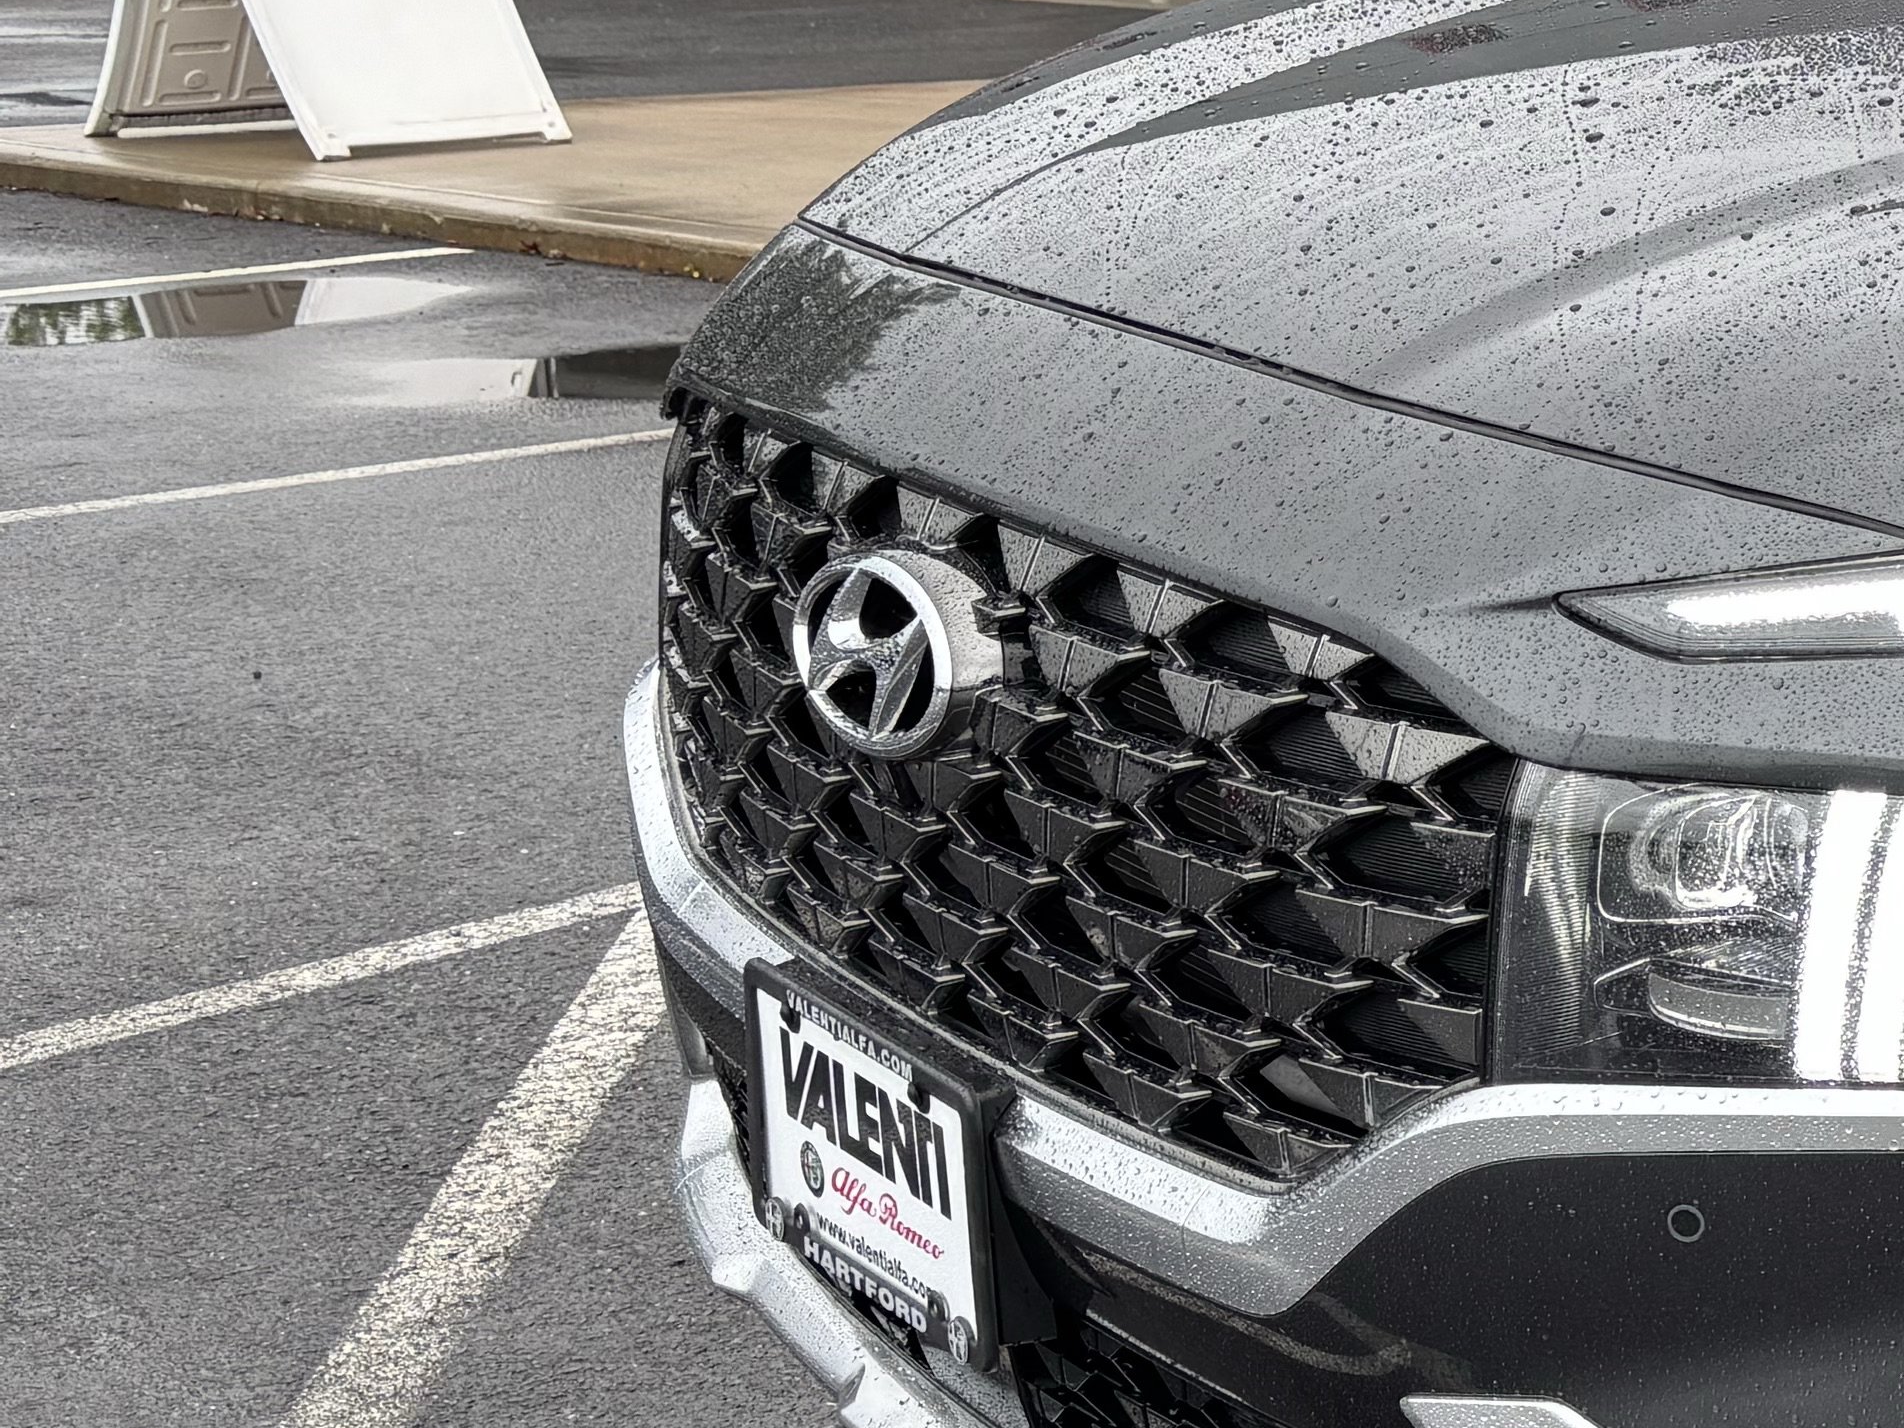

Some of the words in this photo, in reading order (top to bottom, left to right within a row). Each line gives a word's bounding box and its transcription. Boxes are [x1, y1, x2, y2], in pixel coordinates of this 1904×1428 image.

[786, 989, 914, 1083] VALENTIALFA.COM
[779, 1026, 952, 1221] VALENTI
[831, 1167, 876, 1215] Alfa
[879, 1193, 945, 1260] Romeo
[803, 1235, 927, 1333] HARTFORD
